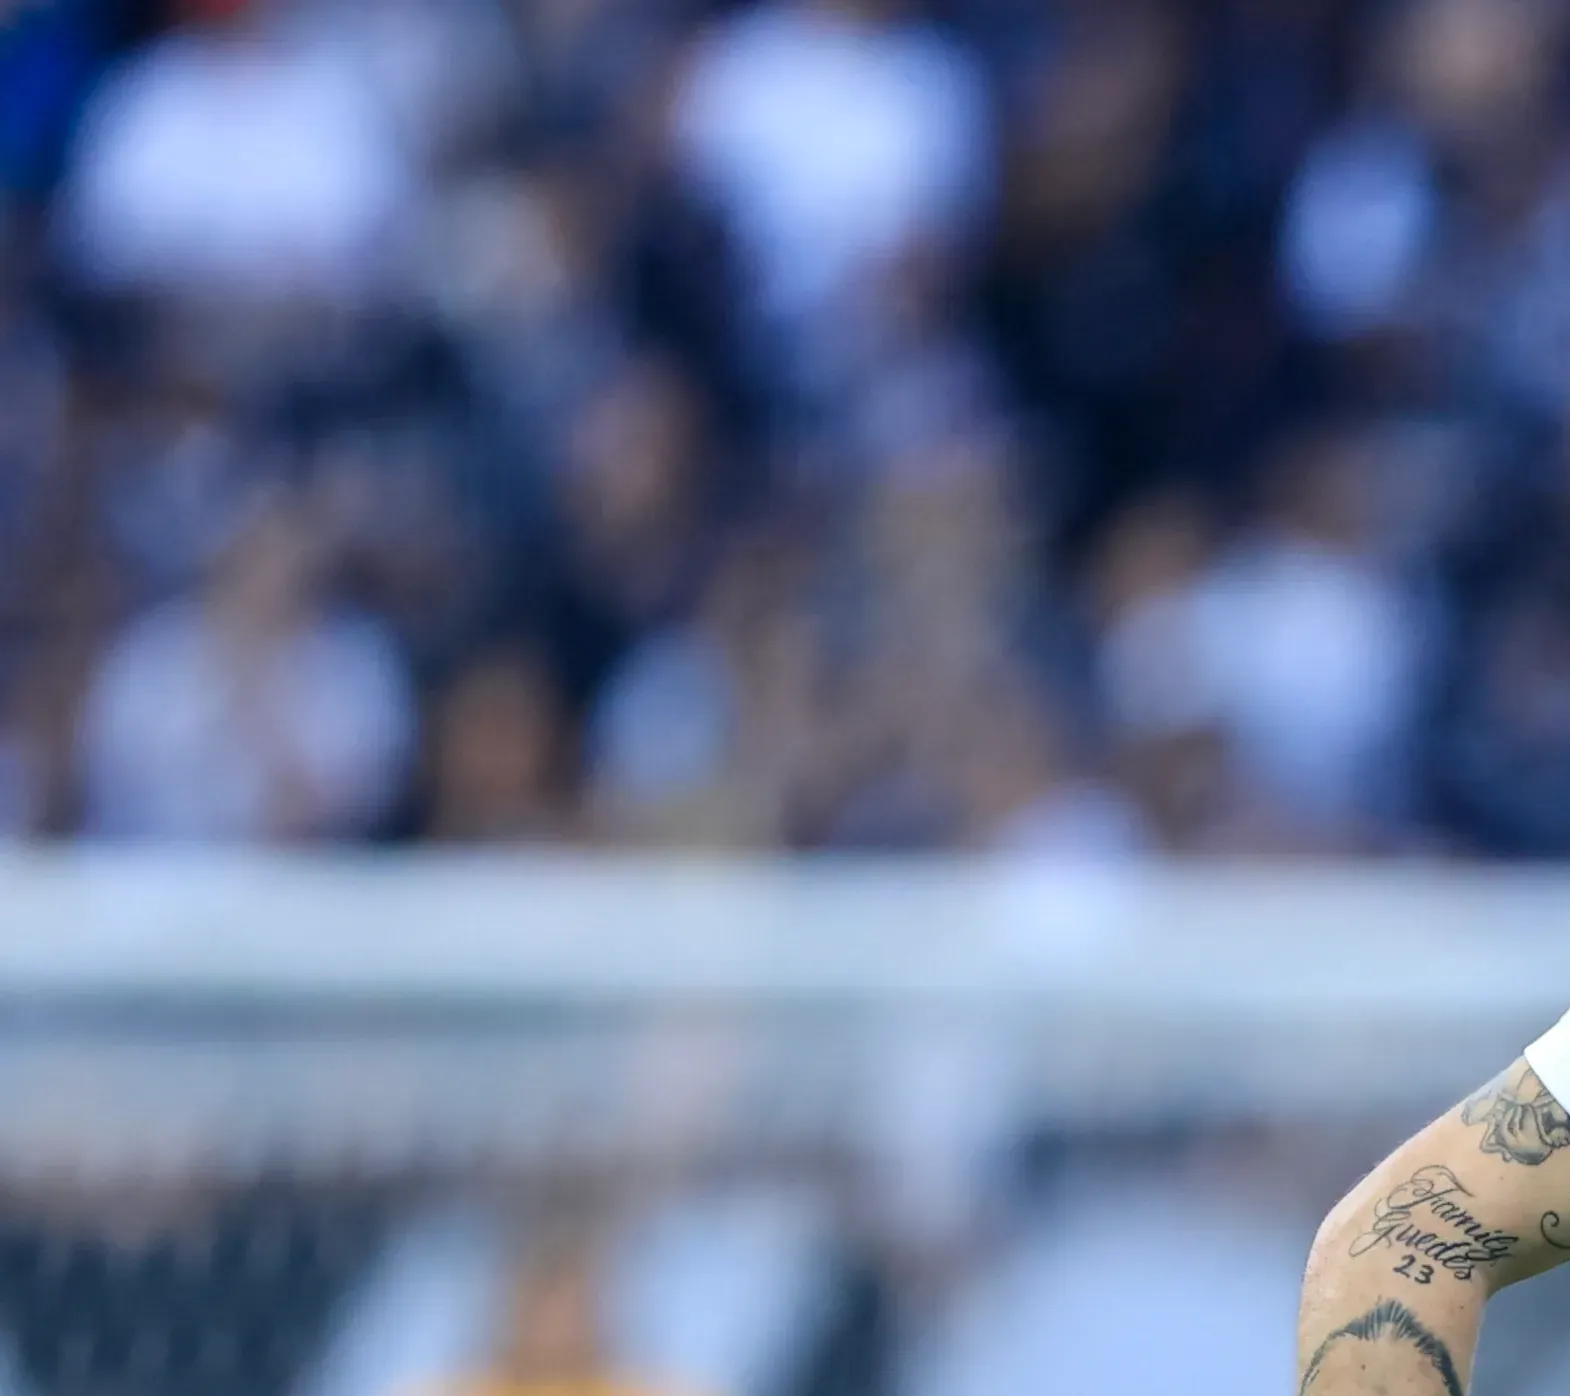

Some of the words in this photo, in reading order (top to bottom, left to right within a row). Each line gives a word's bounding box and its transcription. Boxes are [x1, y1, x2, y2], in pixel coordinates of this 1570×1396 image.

[1349, 1198, 1475, 1282] Guedes
[1387, 1164, 1519, 1264] Family
[1393, 1254, 1435, 1284] 23
